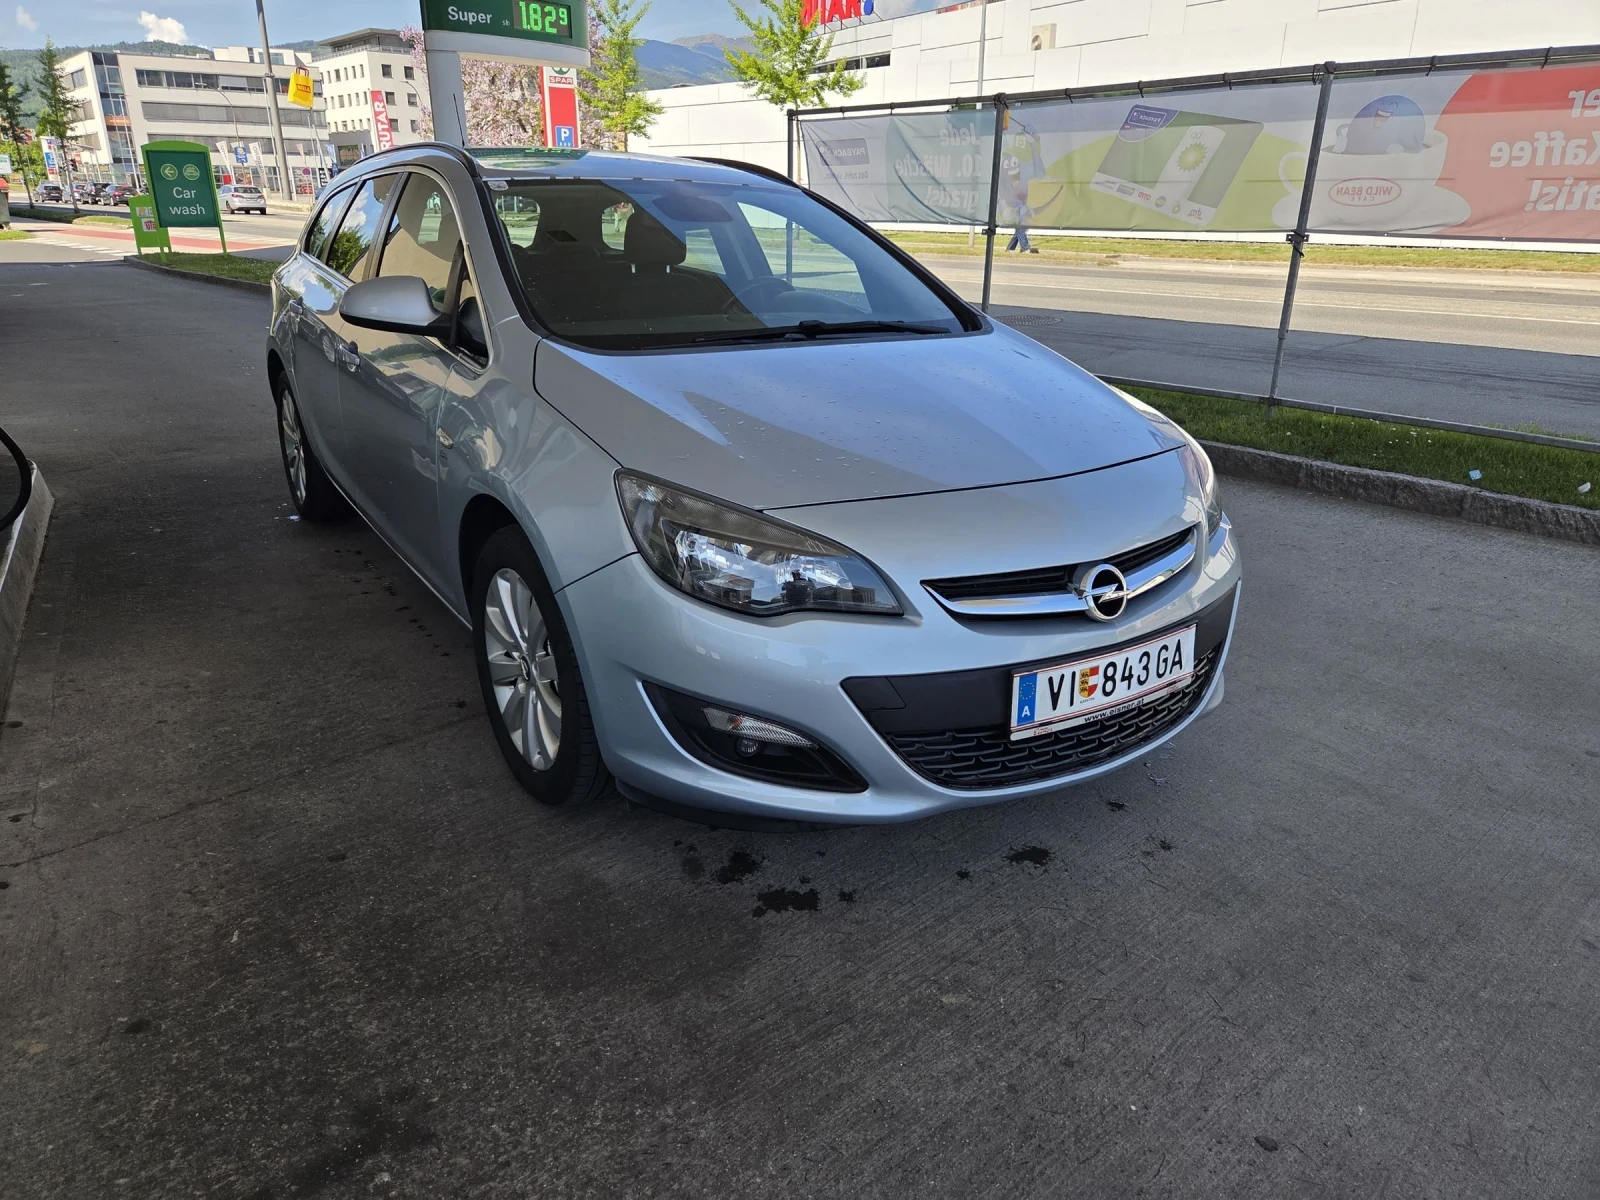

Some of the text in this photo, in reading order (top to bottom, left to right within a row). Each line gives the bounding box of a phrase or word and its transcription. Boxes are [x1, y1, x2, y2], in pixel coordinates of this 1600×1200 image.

[448, 6, 492, 25] Super
[550, 76, 573, 84] SPAR
[373, 101, 392, 150] RUTAR
[561, 128, 570, 141] P
[173, 186, 196, 198] Car
[169, 204, 205, 215] wash
[1048, 671, 1076, 711] VI
[1021, 705, 1031, 718] A
[1084, 698, 1145, 723] www.eisner.at
